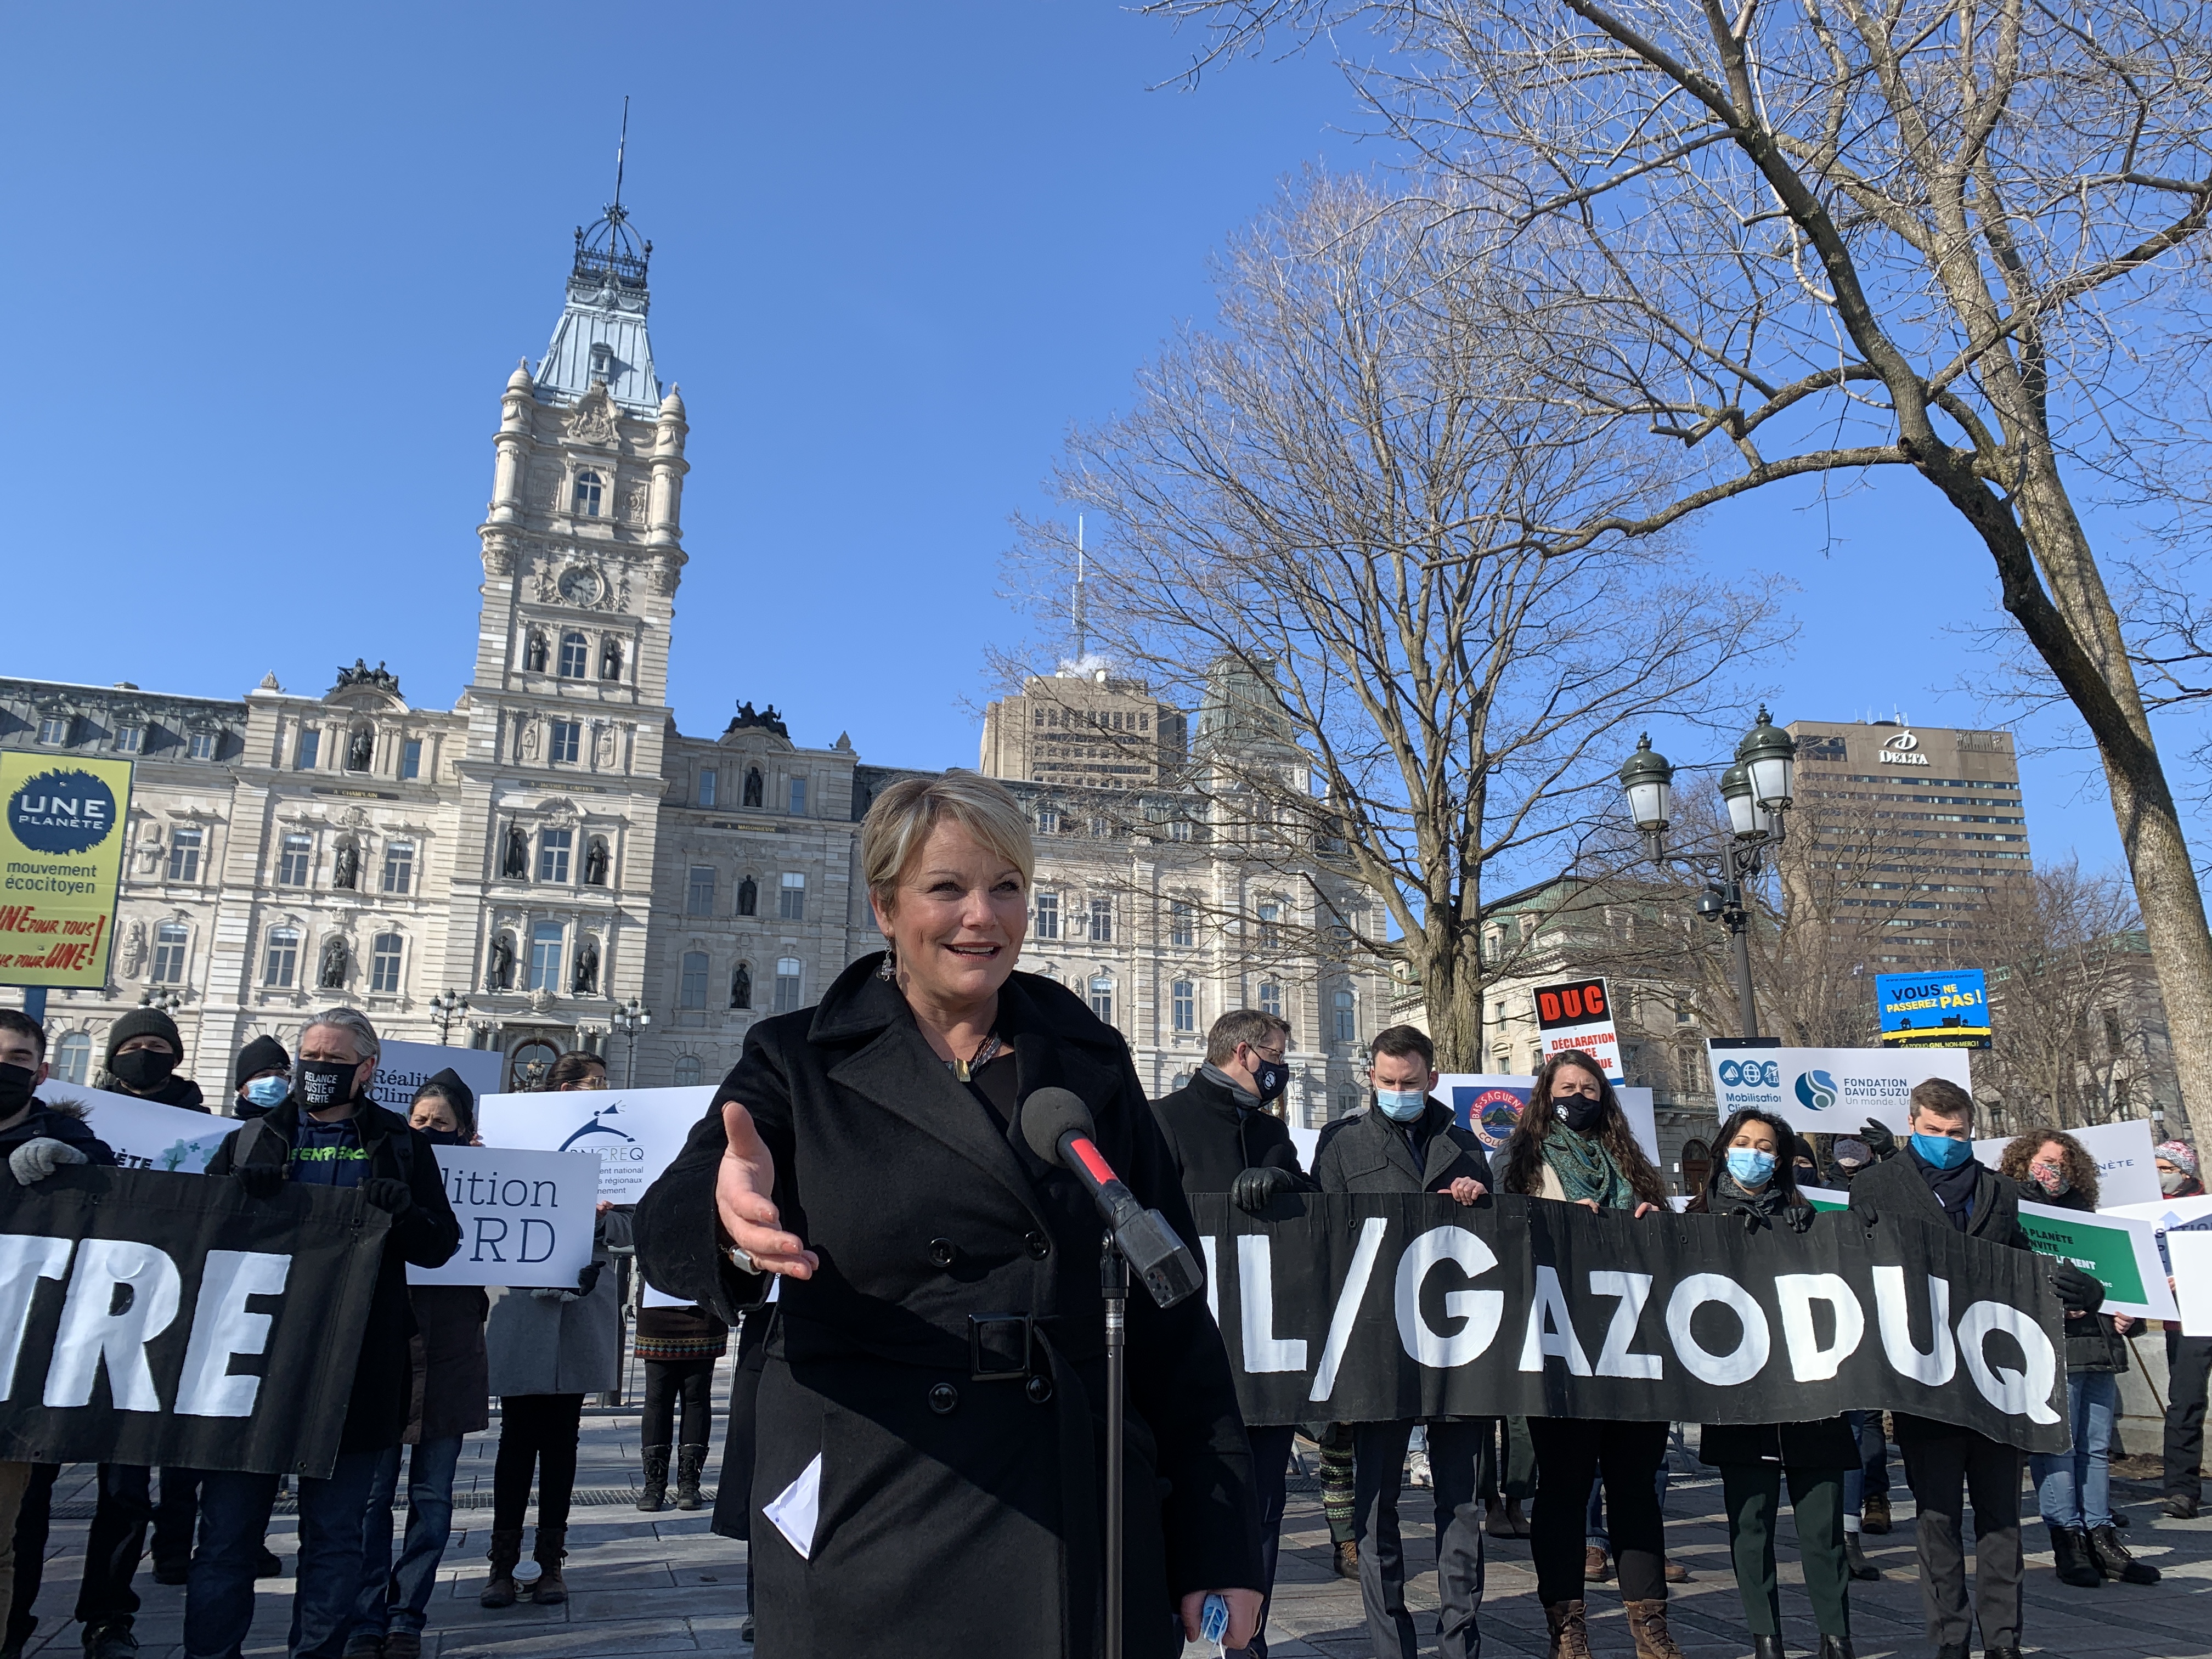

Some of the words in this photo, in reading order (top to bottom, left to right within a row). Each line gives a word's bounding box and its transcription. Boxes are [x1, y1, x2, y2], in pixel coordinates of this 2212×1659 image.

[1878, 750, 1930, 765] DELTA
[342, 790, 377, 799] CHAMPLAIN
[21, 794, 106, 818] UNE
[19, 815, 105, 830] PLANÈTE
[737, 825, 776, 833] MAISONNEUVE
[7, 862, 97, 877] mouvement
[5, 874, 95, 896] écocitoyen
[1891, 984, 1941, 1001] VOUS
[1942, 983, 1959, 994] NE
[1540, 985, 1604, 1021] DUC
[1886, 998, 1938, 1014] PASSEREZ
[1551, 1032, 1616, 1051] DÉCLARATION
[304, 1070, 338, 1084] RELANCE
[1844, 1078, 1908, 1087] FONDATION
[304, 1081, 328, 1094] JUSTE
[1845, 1087, 1877, 1096] DAVID
[1880, 1088, 1913, 1096] SUZU
[307, 1092, 329, 1103] VERTE
[1471, 1091, 1525, 1119] BAS-SAGUENA
[605, 1177, 642, 1186] régionaux
[2029, 1228, 2074, 1245] PLANÈTE
